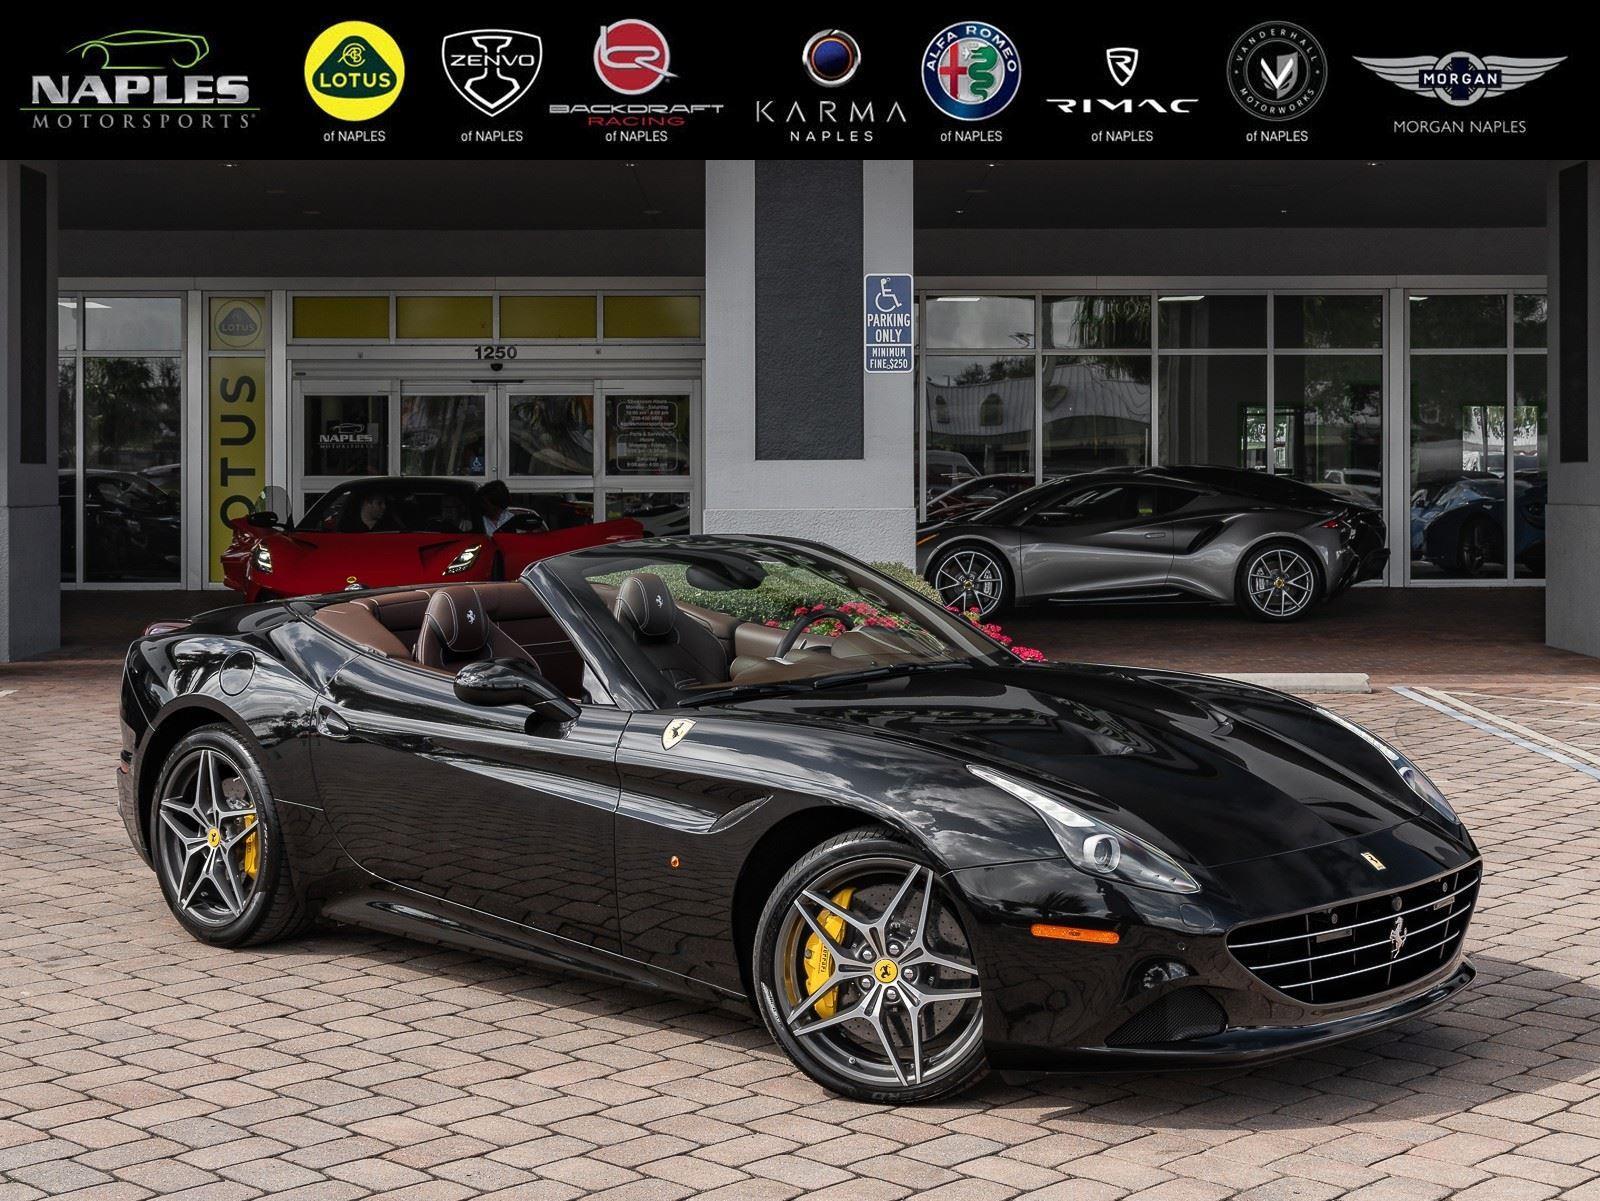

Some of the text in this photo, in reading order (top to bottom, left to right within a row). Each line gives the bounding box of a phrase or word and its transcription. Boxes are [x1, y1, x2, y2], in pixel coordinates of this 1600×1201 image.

[867, 313, 911, 327] PARKING
[223, 323, 256, 332] LOTUS
[875, 329, 903, 343] ONLY
[474, 345, 518, 360] 1250
[872, 347, 906, 357] MINIMUM
[870, 358, 908, 369] FINE $250
[320, 434, 373, 443] NAPLES
[220, 375, 257, 530] OTUS
